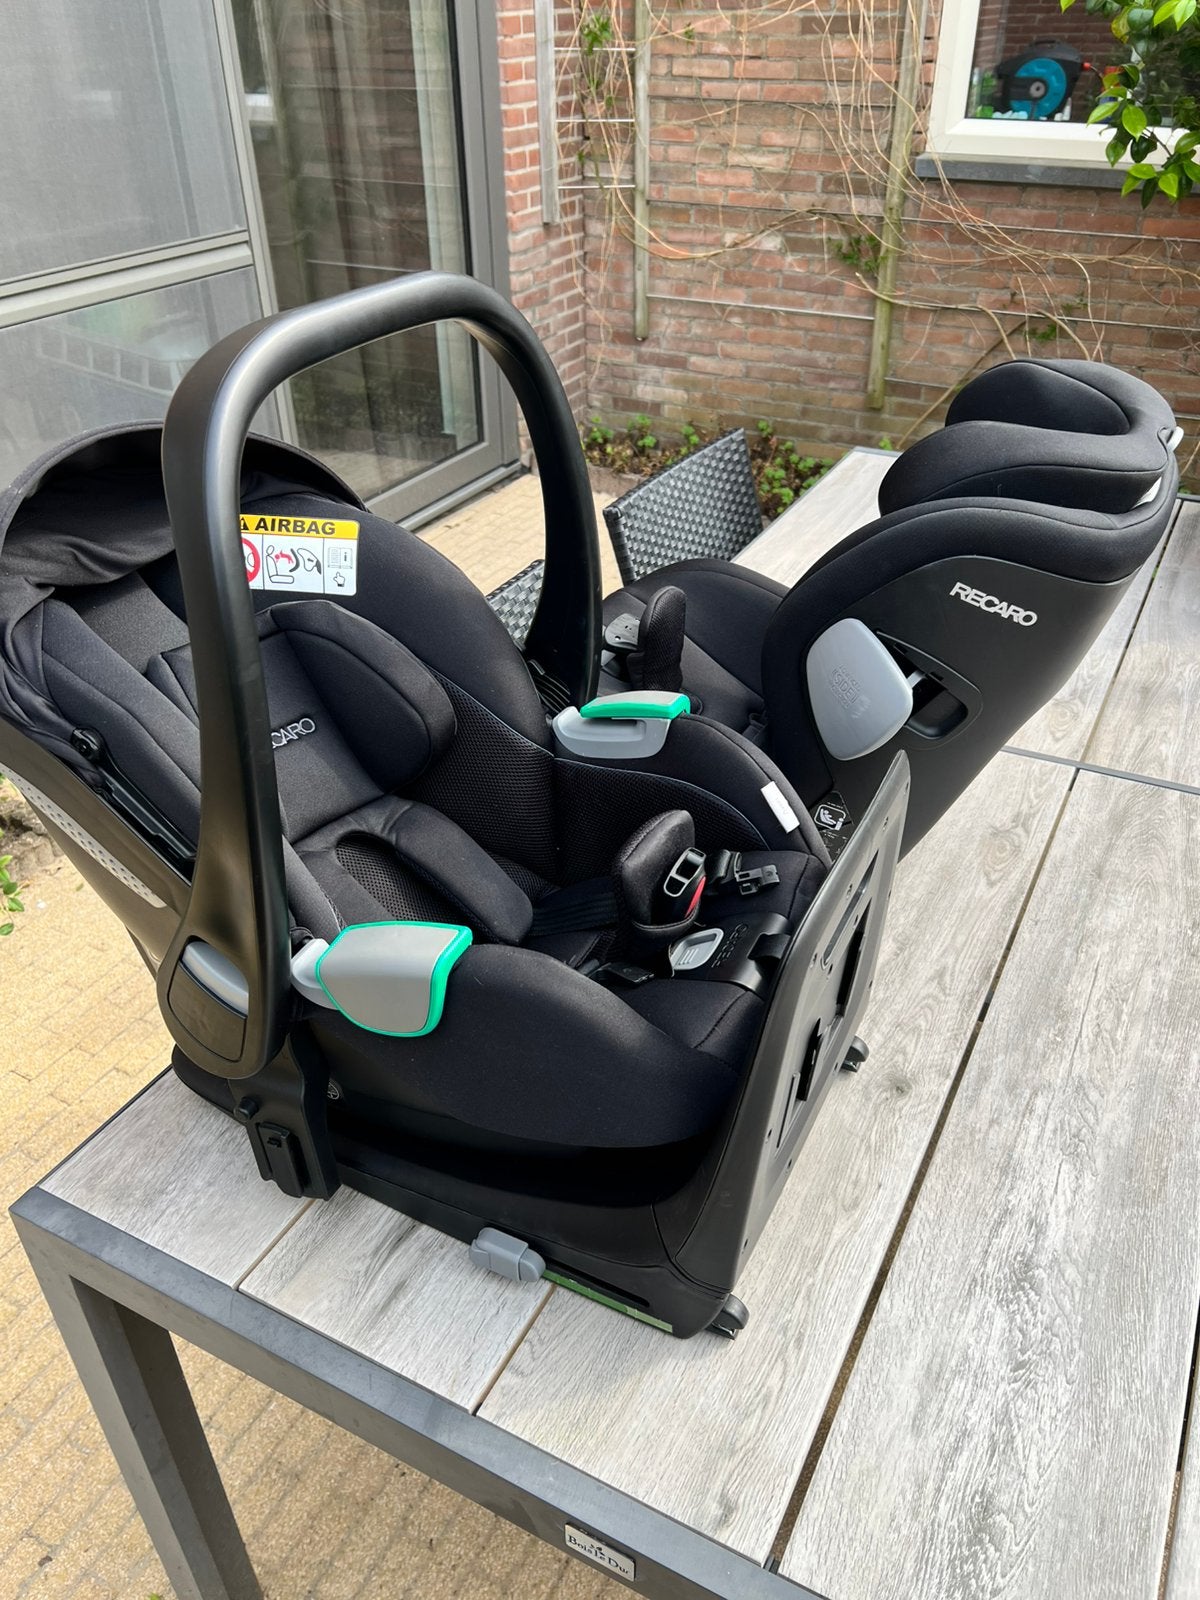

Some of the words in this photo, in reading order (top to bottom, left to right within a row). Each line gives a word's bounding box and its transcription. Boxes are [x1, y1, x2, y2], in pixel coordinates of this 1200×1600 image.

[255, 517, 336, 535] AIRBAG
[949, 581, 1038, 627] RECARO
[270, 717, 316, 749] CARO
